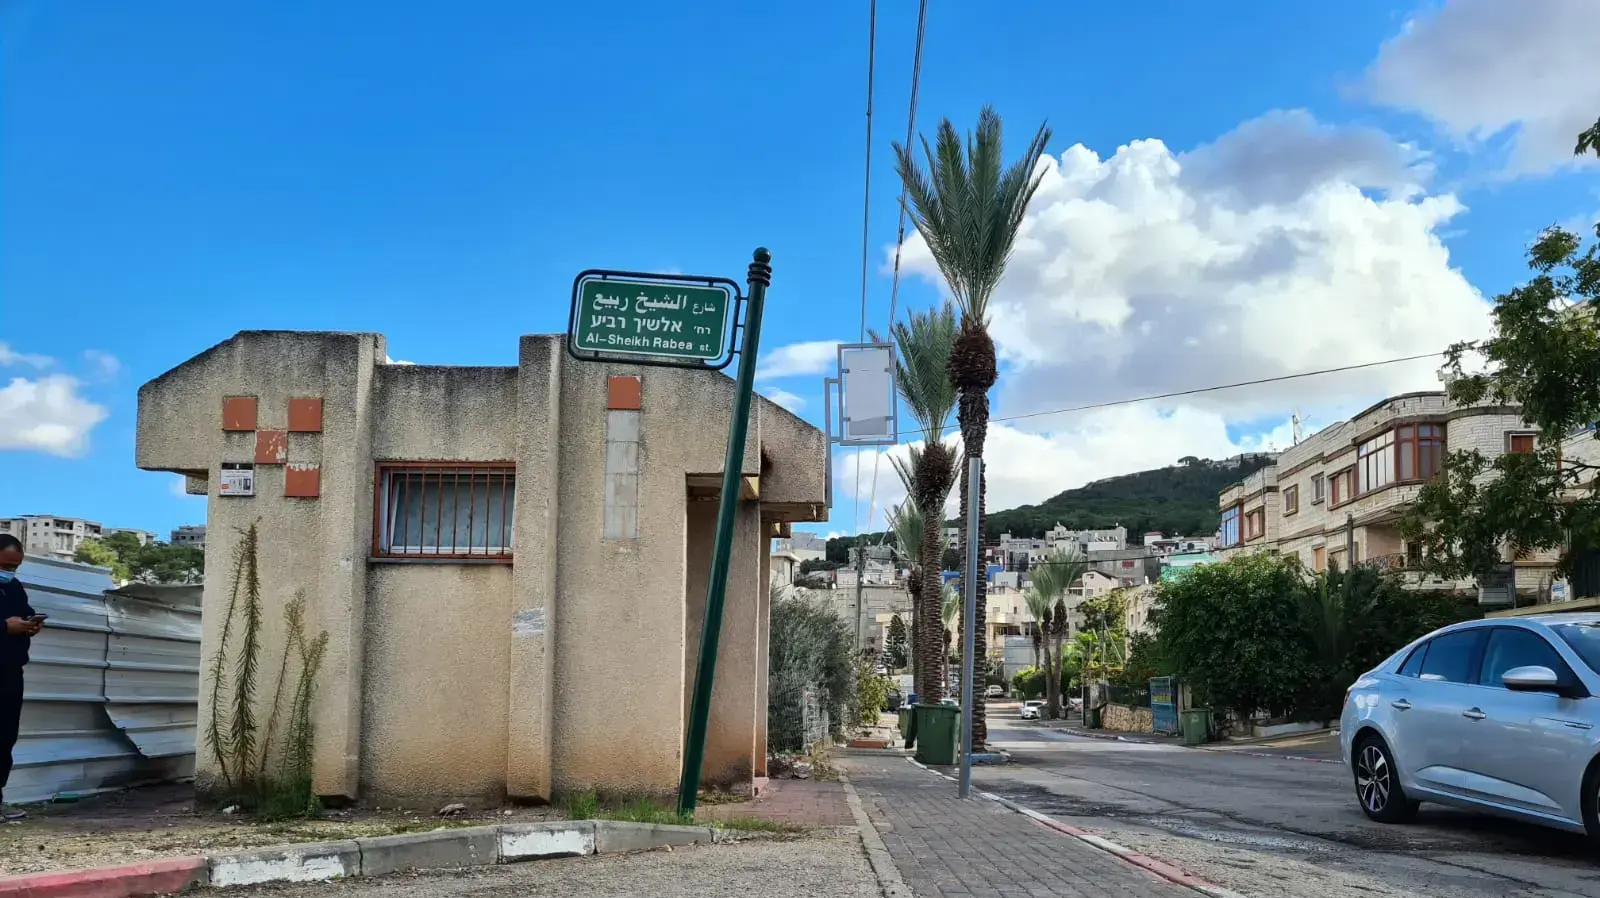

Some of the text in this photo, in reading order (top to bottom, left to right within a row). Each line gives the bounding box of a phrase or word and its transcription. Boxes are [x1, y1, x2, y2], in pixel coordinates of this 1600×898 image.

[592, 291, 716, 315] شارع الشيخ ربيع
[590, 314, 626, 329] רביע
[633, 316, 682, 333] אלשיך
[585, 332, 712, 352] Al-Sheikh Rabea st.
